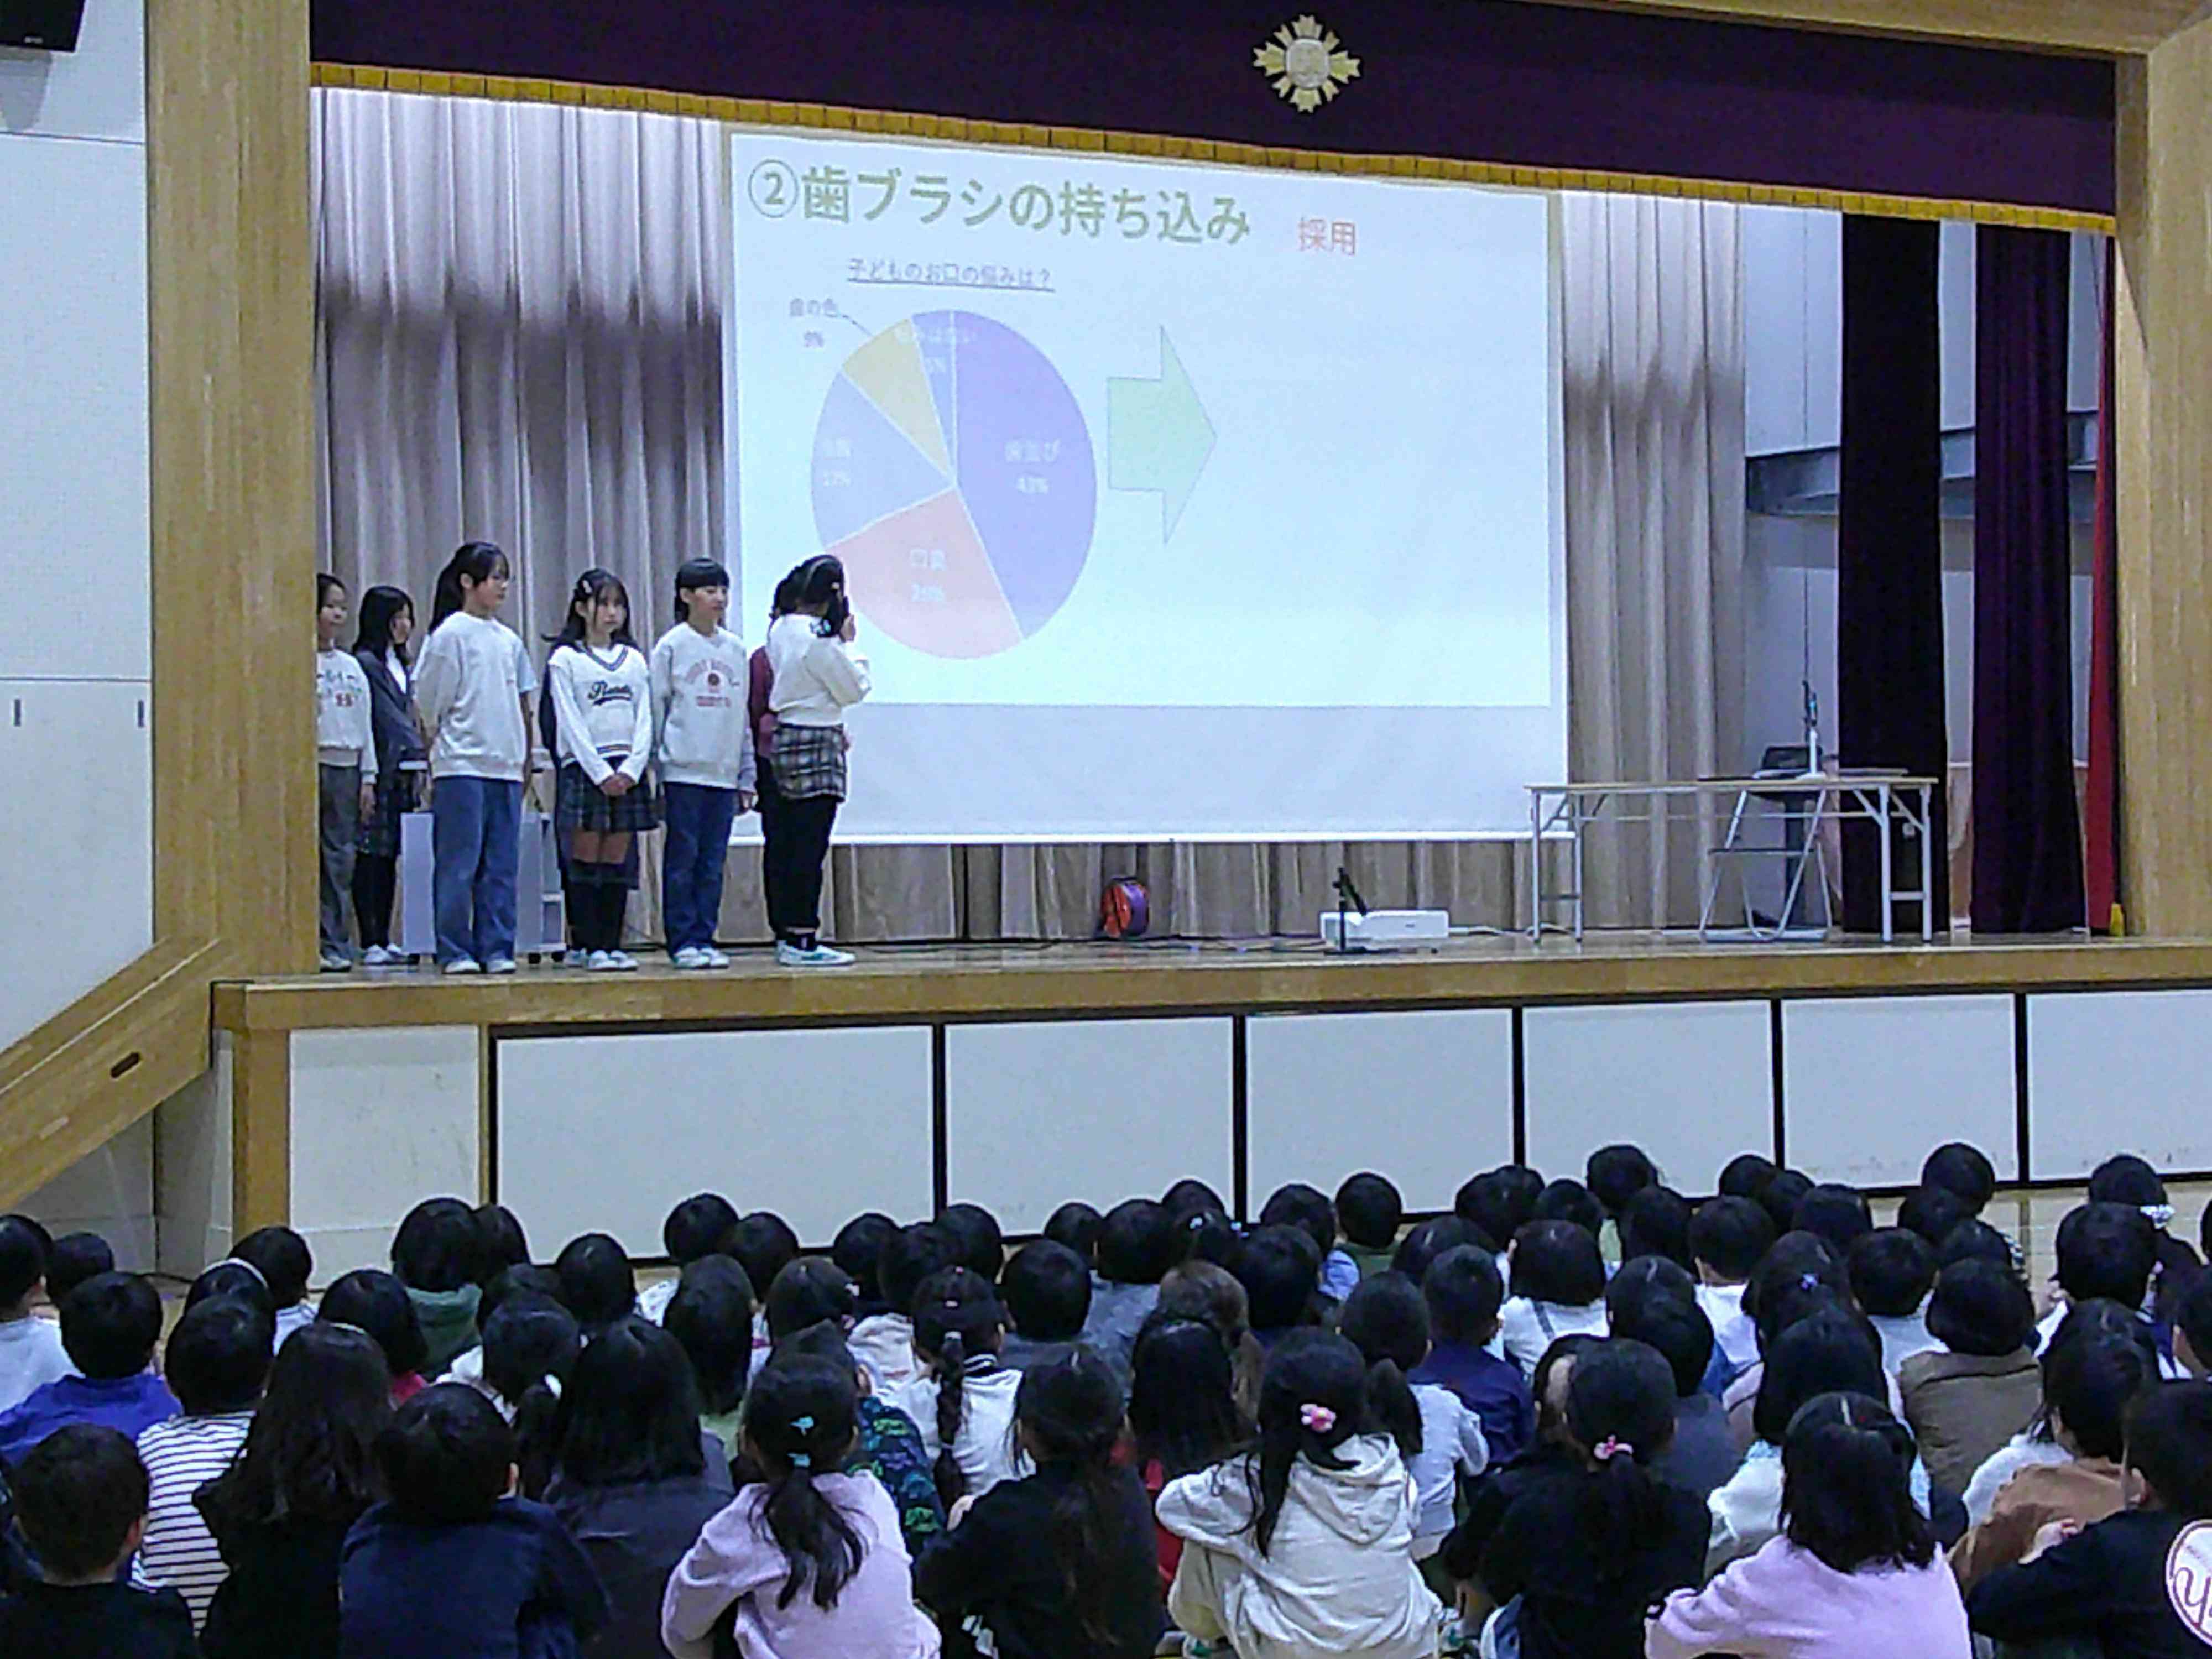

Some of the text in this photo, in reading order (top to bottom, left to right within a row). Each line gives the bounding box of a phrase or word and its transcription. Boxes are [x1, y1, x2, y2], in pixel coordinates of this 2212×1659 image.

[748, 159, 1250, 244] ②歯ブラシの持ち込み
[1297, 217, 1356, 257] 採用
